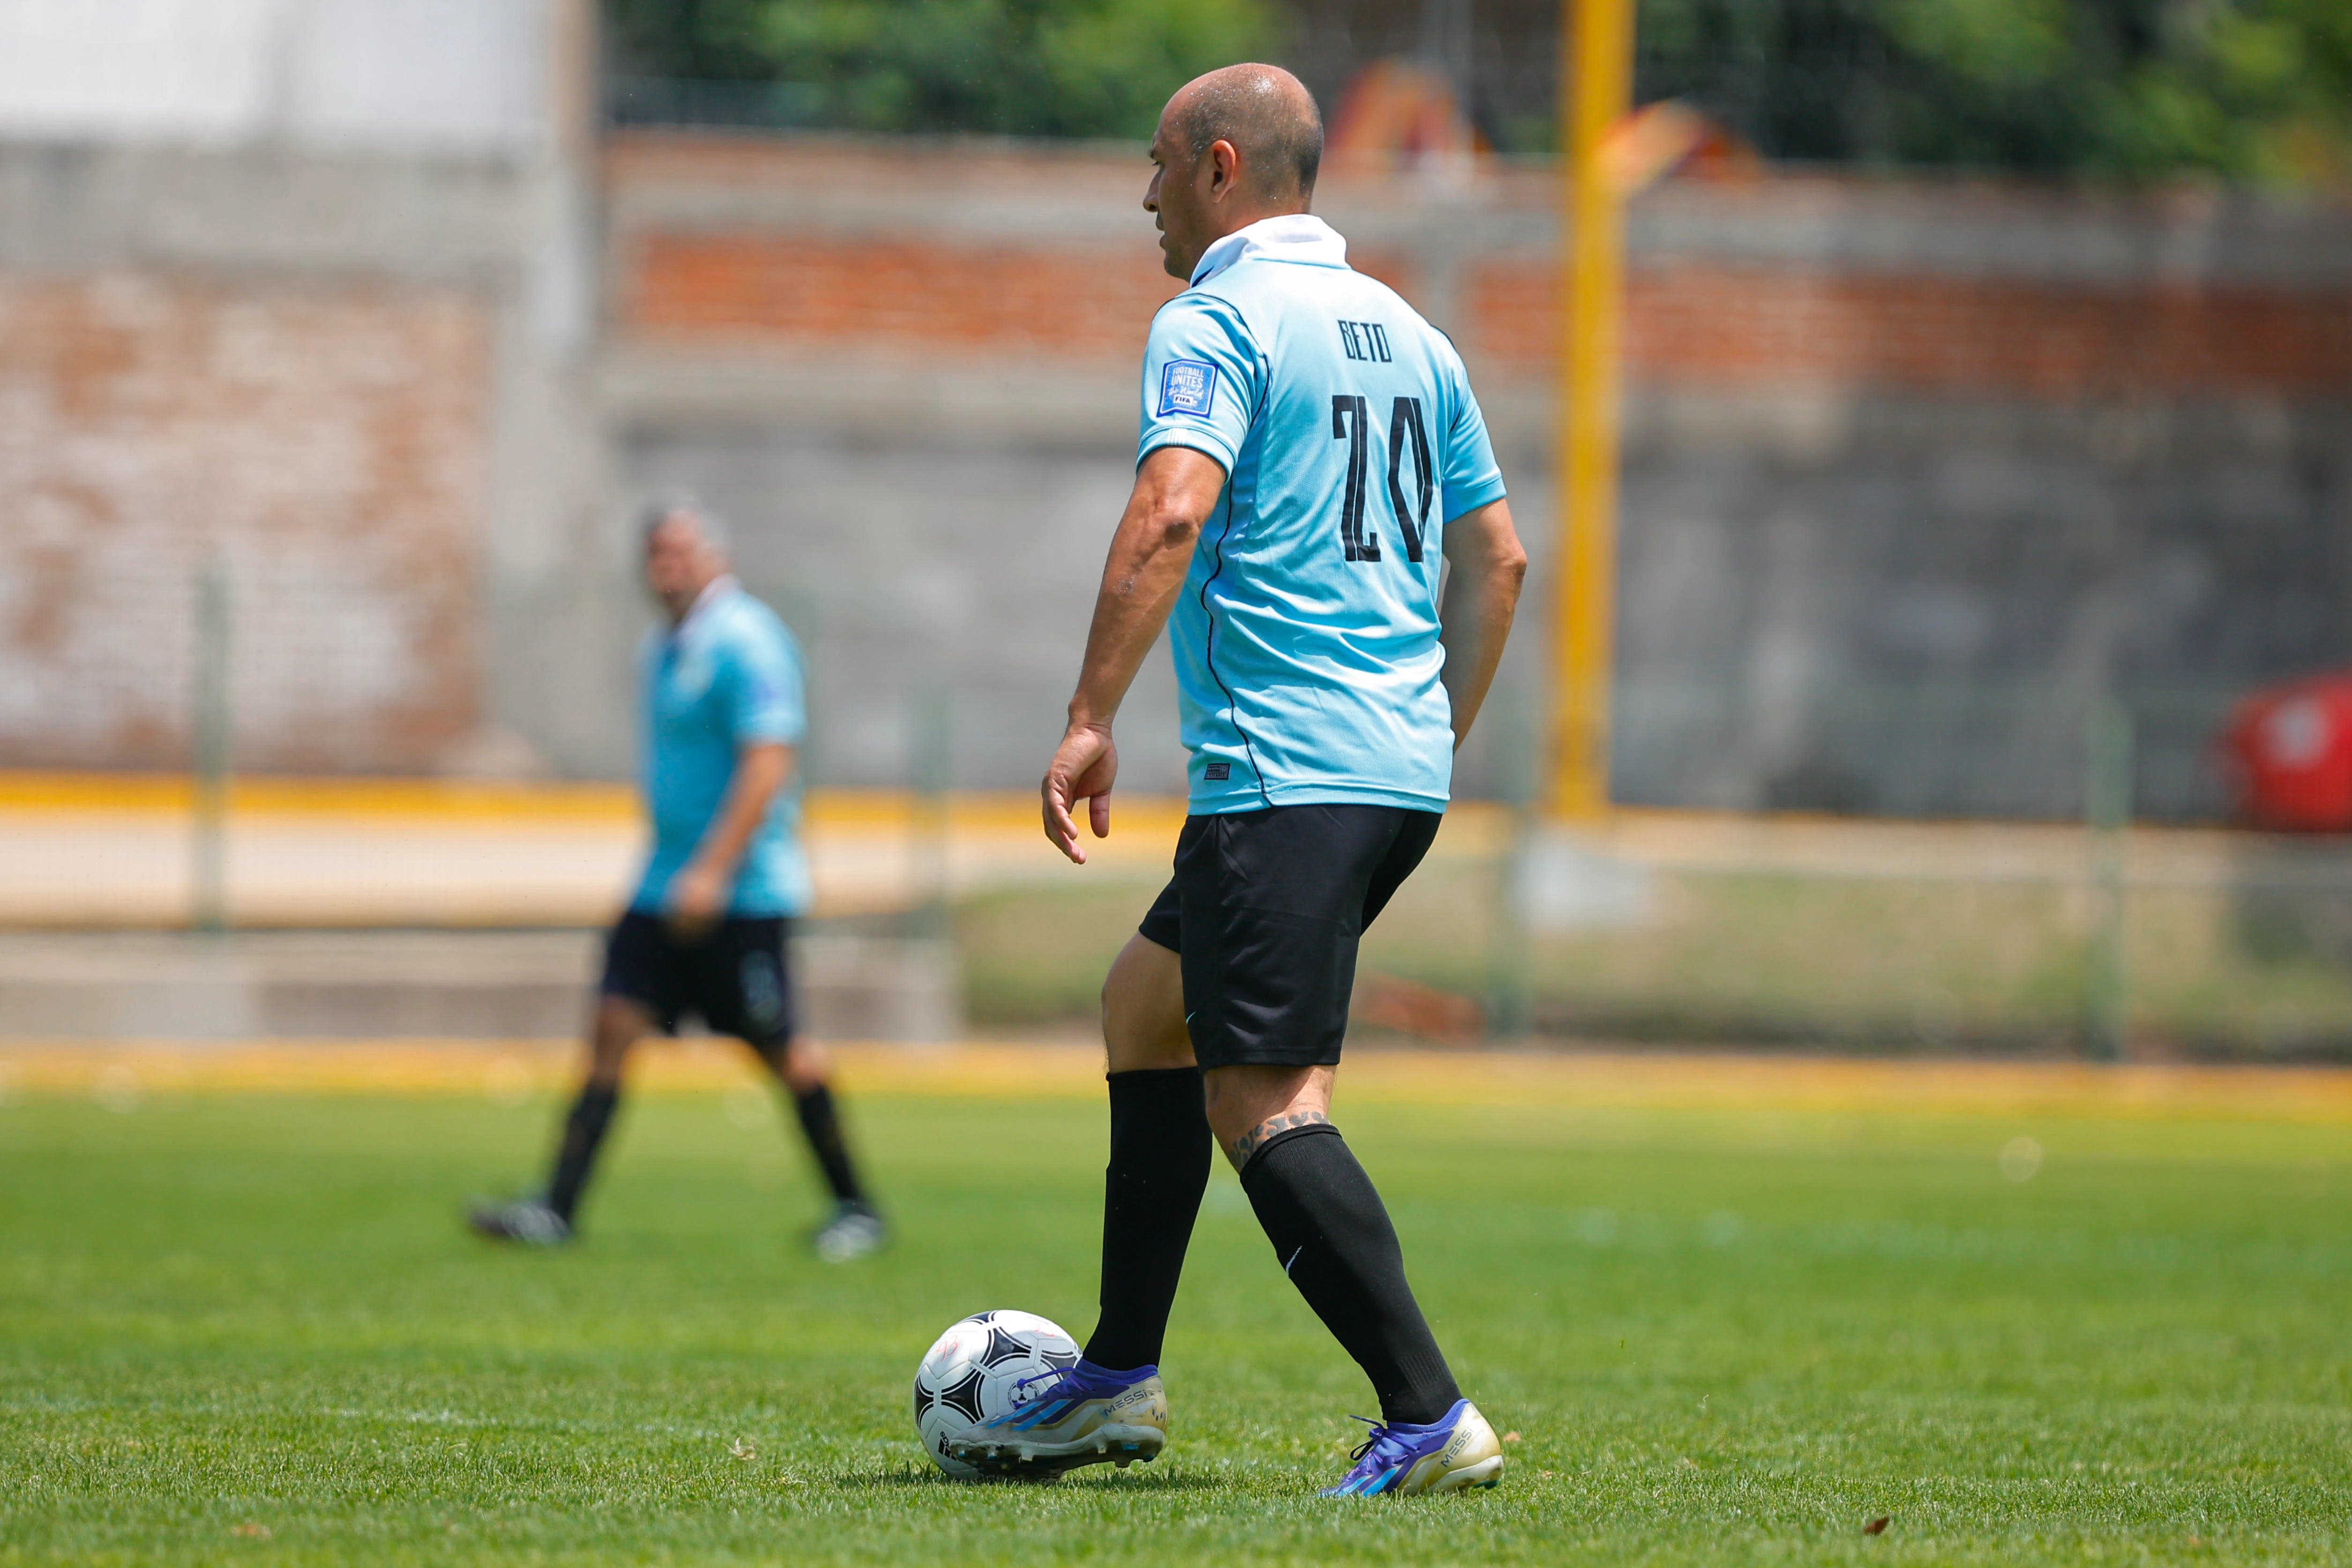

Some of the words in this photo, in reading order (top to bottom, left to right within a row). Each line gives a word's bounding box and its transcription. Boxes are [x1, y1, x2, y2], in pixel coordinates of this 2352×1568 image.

[1337, 320, 1392, 362] BETO
[1171, 374, 1203, 388] UNITES
[1172, 366, 1203, 378] FOOTBALL
[1332, 395, 1433, 563] 20
[935, 1335, 958, 1361] 93
